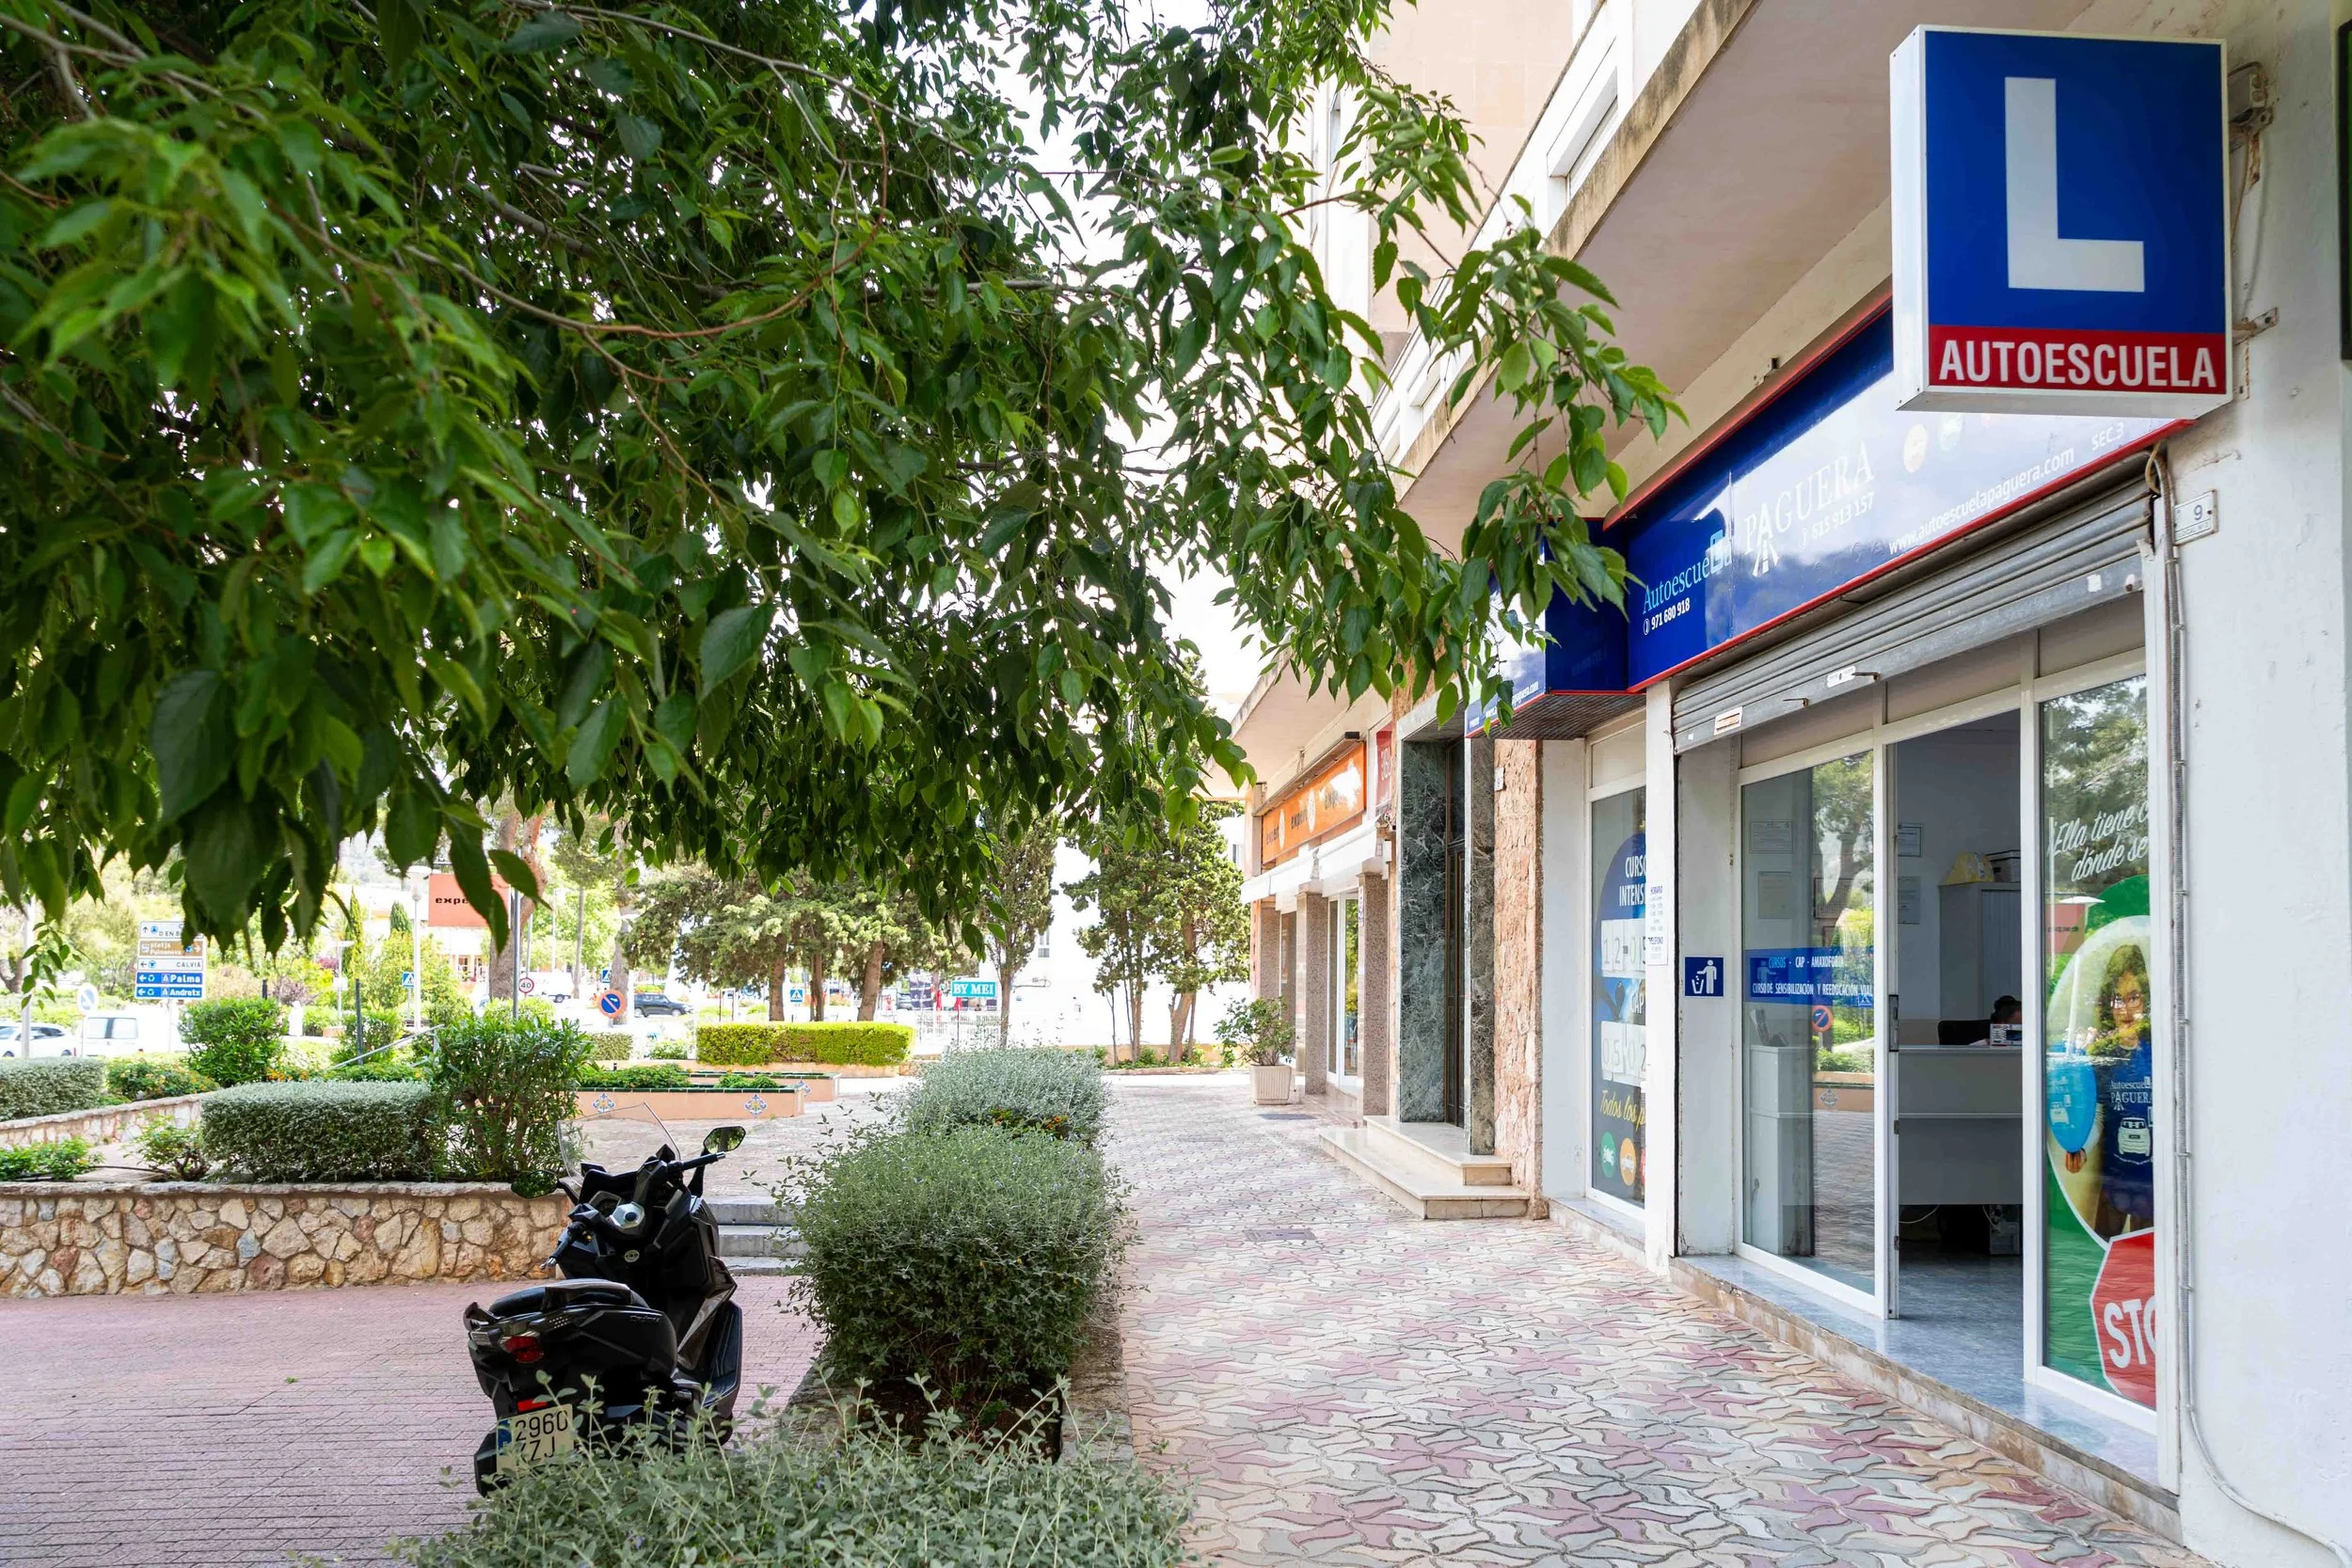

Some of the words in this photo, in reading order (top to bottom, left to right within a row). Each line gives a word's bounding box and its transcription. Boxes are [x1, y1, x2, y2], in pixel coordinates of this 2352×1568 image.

[2005, 76, 2145, 293] L
[1939, 340, 2217, 388] AUTOESCUELA
[1743, 440, 1875, 564] PAGUERA
[1888, 448, 2075, 556] www.autoescuelapaguera.com
[2193, 504, 2203, 521] 9
[1651, 614, 1663, 631] 971
[1663, 605, 1677, 626] 680
[1677, 596, 1691, 616] 918
[2090, 804, 2135, 841] tiene
[2071, 834, 2125, 882] dónde
[169, 974, 201, 983] Palma
[1769, 957, 1787, 969] CURSOS
[1795, 957, 1805, 968] CAP
[953, 984, 968, 994] BY
[971, 984, 994, 995] MEI
[1817, 984, 1822, 995] Y
[1600, 1088, 1622, 1120] Todos
[1624, 1094, 1638, 1124] los
[516, 1410, 568, 1442] 2960
